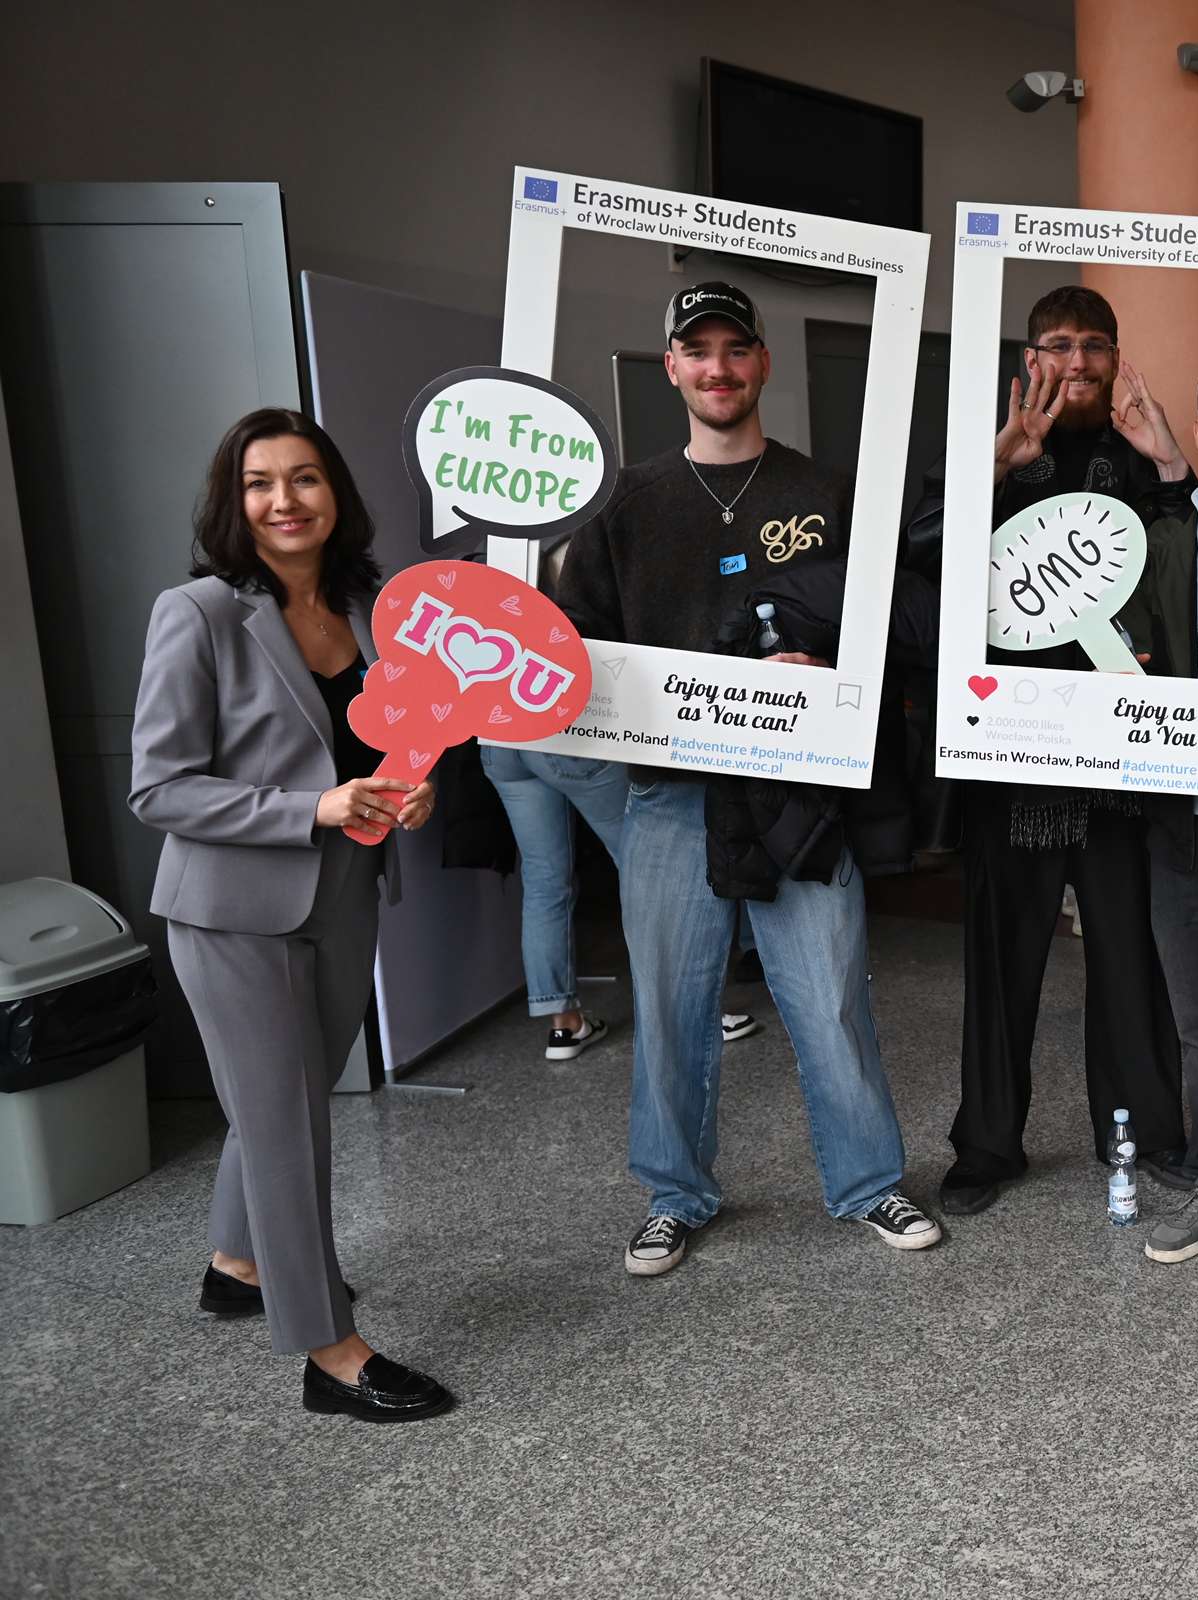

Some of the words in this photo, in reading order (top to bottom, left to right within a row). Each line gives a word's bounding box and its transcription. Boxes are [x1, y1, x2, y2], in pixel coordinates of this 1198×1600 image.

[514, 200, 567, 216] Erasmus+
[574, 182, 688, 218] Erasmus+
[693, 202, 797, 238] Students
[1014, 213, 1125, 239] Erasmus+
[577, 211, 592, 223] of
[595, 213, 656, 233] Wroclaw
[659, 223, 729, 247] University
[731, 237, 745, 248] of
[747, 237, 817, 259] Economics
[820, 252, 844, 264] and
[848, 253, 904, 274] Business
[959, 236, 1009, 249] Erasmus+
[1018, 241, 1032, 252] of
[1035, 241, 1094, 257] Wroclaw
[1097, 244, 1166, 263] University
[1168, 250, 1182, 262] of
[429, 400, 491, 442] I'm
[508, 414, 595, 463] From
[435, 452, 580, 513] EUROPE
[1009, 530, 1102, 617] OMG
[399, 597, 449, 651] I
[514, 653, 570, 709] U
[591, 693, 613, 704] ikes
[663, 674, 720, 704] Enjoy
[723, 687, 749, 702] as
[751, 691, 809, 710] much
[677, 706, 702, 721] as
[707, 704, 748, 728] You
[751, 714, 798, 733] can!
[1113, 697, 1169, 726] Enjoy
[1172, 707, 1197, 721] as
[623, 730, 669, 746] Poland
[671, 736, 747, 756] #adventure
[750, 745, 803, 762] #poland
[806, 751, 870, 769] #wroclaw
[1038, 733, 1072, 745] Polska
[1127, 729, 1152, 743] as
[1157, 726, 1198, 747] You
[670, 750, 783, 774] #www.ue.wroc.pl
[939, 746, 993, 762] Erasmus
[996, 749, 1008, 762] in
[1010, 751, 1073, 768] Wrocław,
[1075, 756, 1120, 771] Poland
[1122, 759, 1197, 776] #adventure
